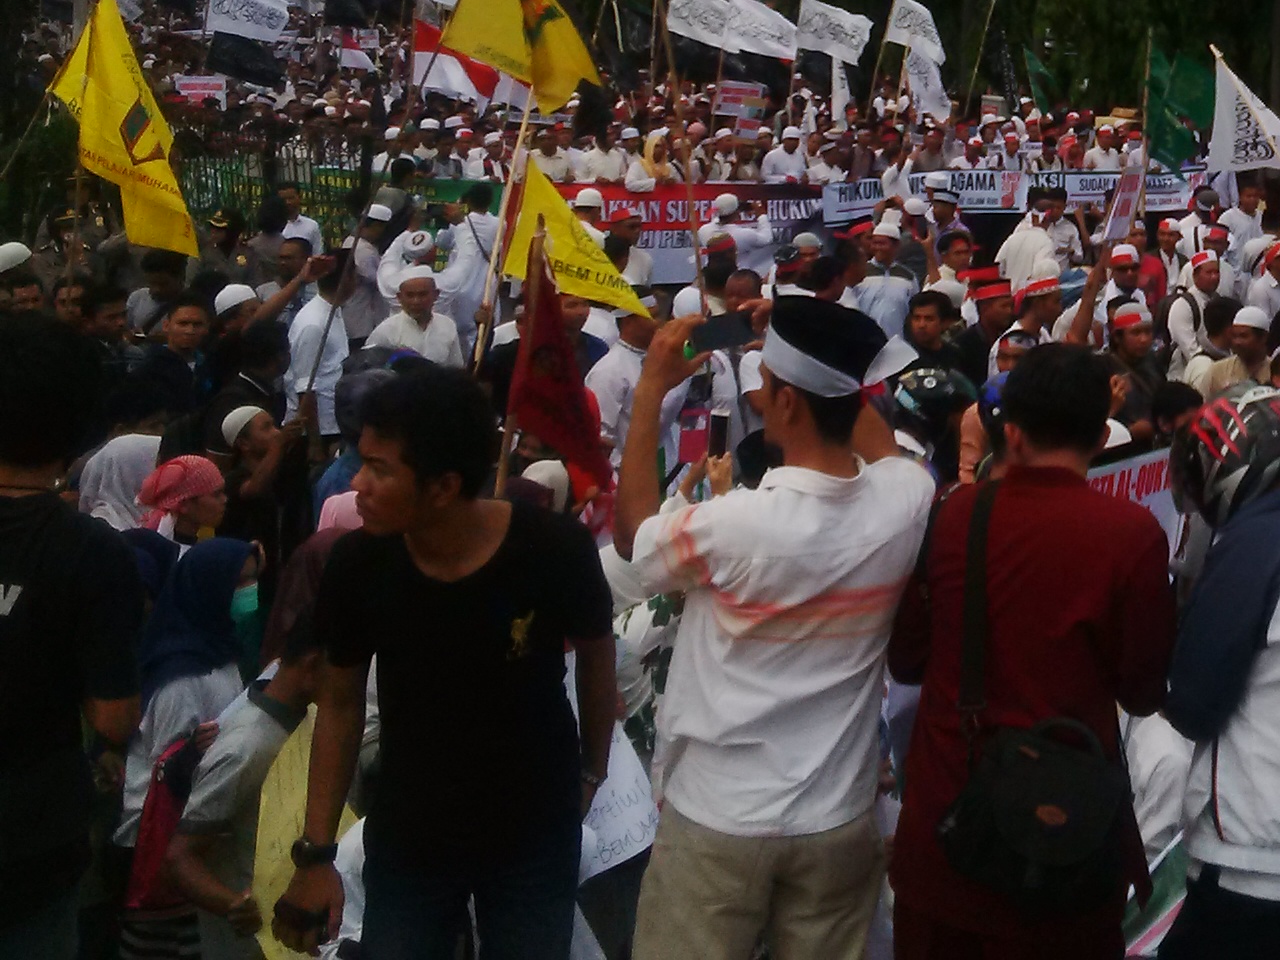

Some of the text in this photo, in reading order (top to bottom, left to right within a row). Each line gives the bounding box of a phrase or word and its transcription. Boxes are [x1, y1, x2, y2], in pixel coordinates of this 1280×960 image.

[950, 172, 996, 192] AGAMA
[1028, 173, 1064, 188] AKSI
[767, 198, 824, 222] HUKUM
[553, 259, 591, 282] BEM
